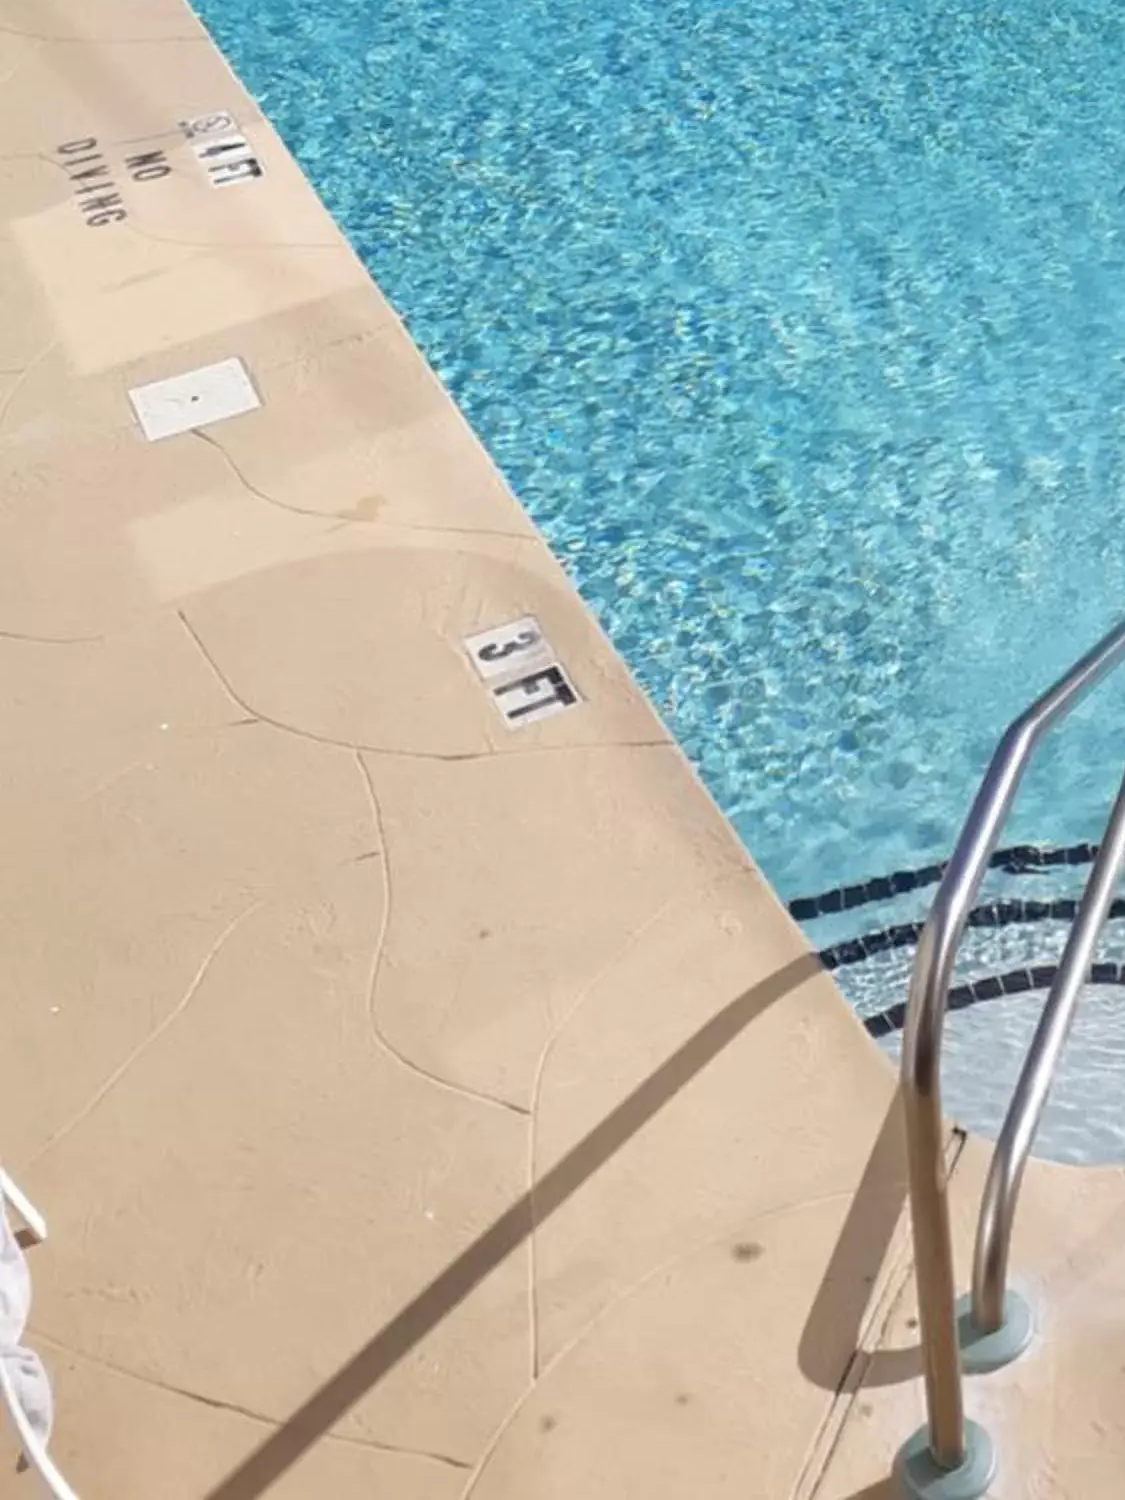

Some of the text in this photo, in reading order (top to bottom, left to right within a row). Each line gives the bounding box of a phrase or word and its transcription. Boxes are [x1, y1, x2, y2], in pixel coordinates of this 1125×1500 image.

[57, 137, 127, 227] DIVING
[124, 151, 172, 182] NO
[478, 631, 577, 719] 3 FT
